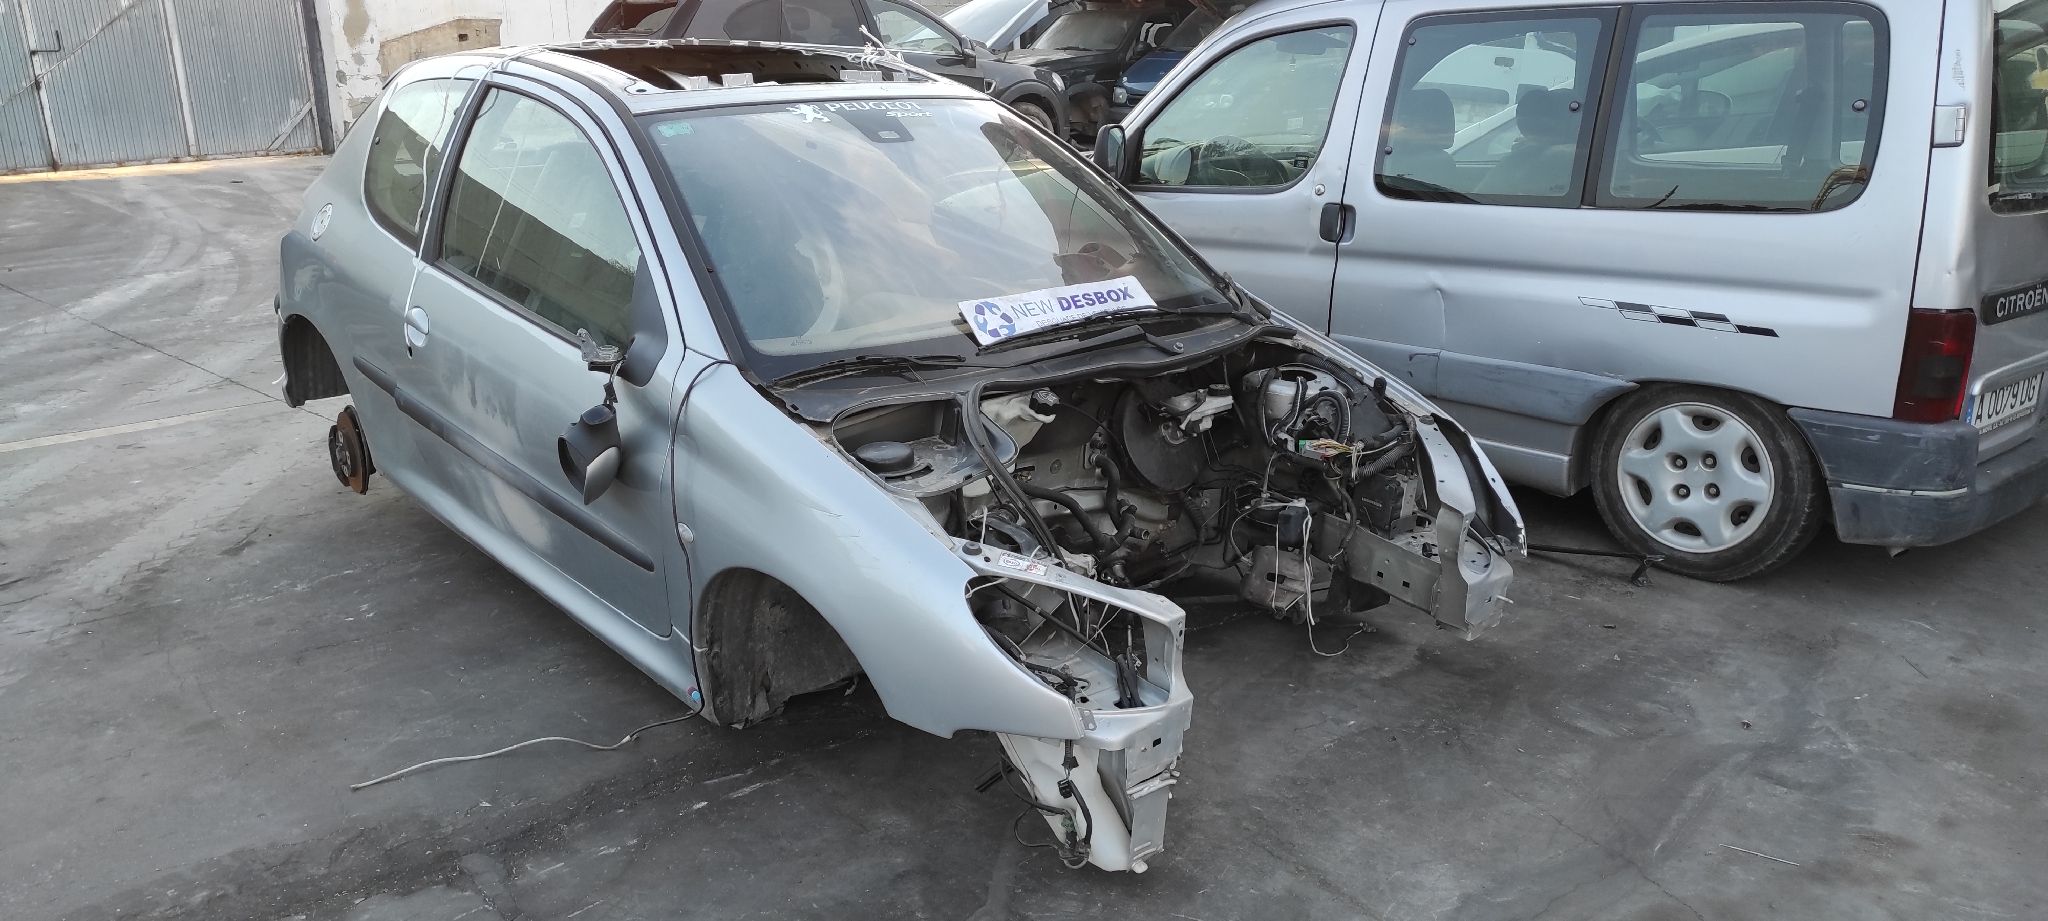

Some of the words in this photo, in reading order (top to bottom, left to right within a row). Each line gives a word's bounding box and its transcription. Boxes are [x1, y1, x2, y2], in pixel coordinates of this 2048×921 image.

[823, 101, 923, 112] PEUGEOT
[1010, 299, 1054, 320] NEW
[1057, 286, 1135, 311] DESBOX
[1975, 393, 1984, 425] A
